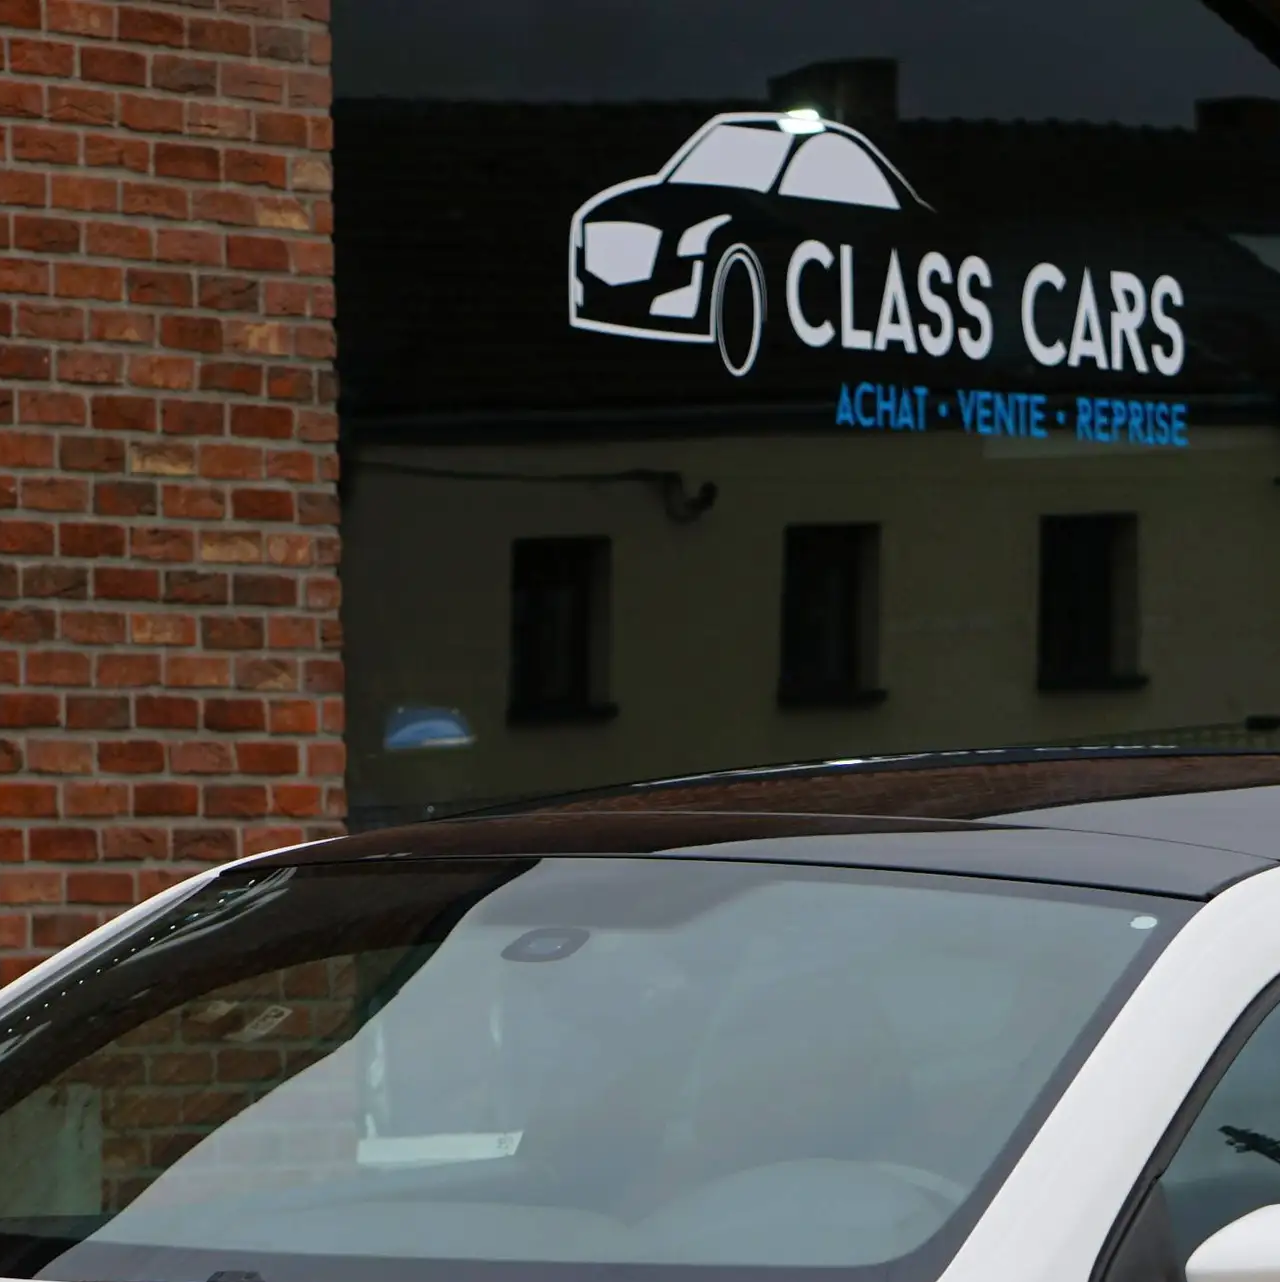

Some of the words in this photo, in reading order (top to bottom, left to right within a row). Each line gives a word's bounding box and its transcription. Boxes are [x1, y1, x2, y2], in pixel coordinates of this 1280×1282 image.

[786, 239, 993, 360] CLASS
[1021, 262, 1186, 377] CARS
[835, 382, 929, 431] ACHAT
[956, 389, 1048, 439] VENTE
[1076, 396, 1189, 447] REPRISE
